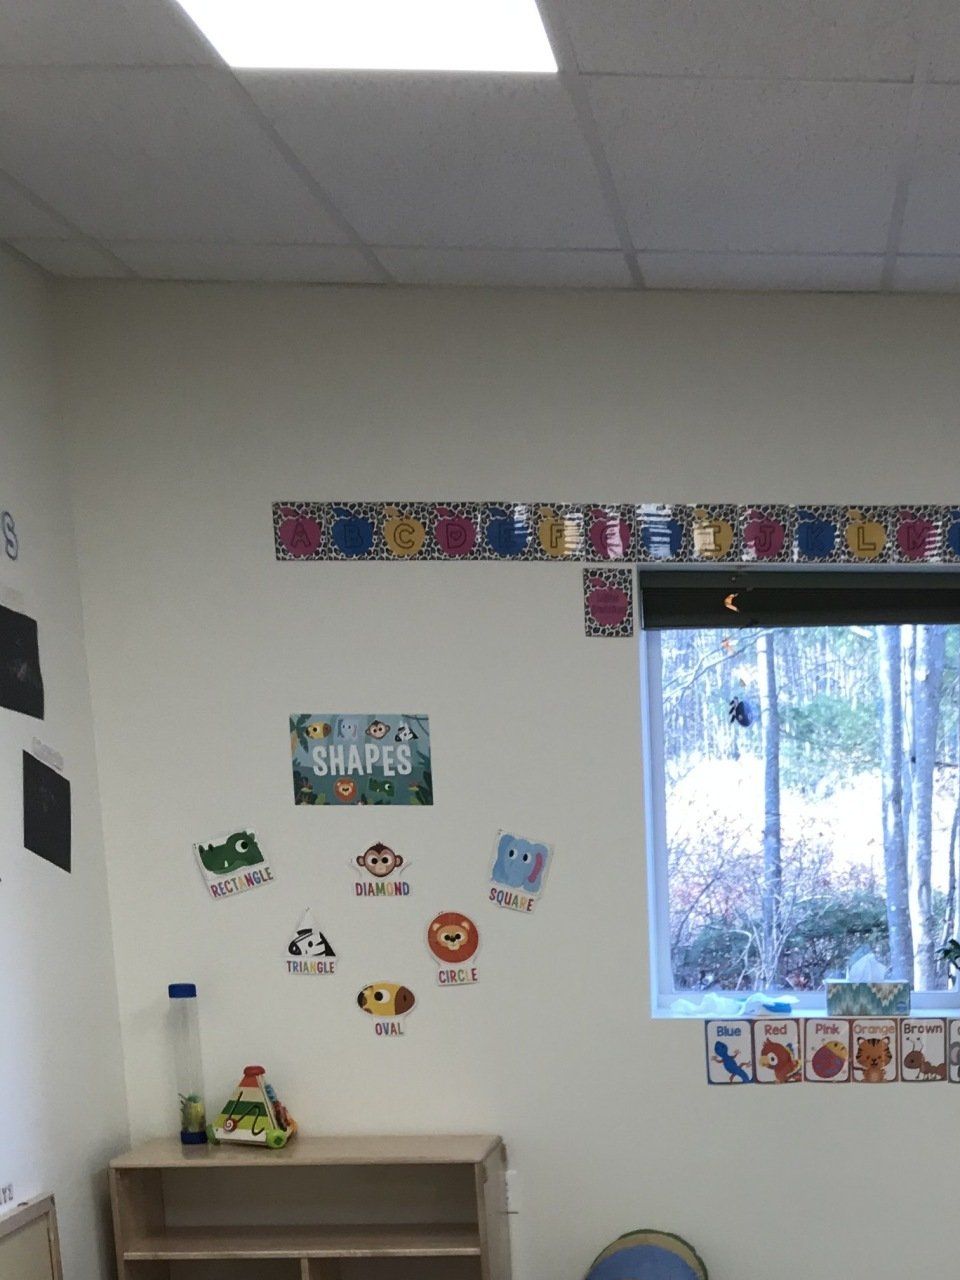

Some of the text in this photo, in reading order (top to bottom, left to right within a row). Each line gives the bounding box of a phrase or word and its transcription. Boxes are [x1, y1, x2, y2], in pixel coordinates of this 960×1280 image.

[290, 523, 312, 547] A
[344, 524, 364, 547] B
[394, 523, 415, 548] C
[446, 523, 467, 549] D
[550, 523, 565, 548] F
[755, 525, 775, 552] J
[857, 526, 876, 551] L
[312, 743, 412, 776] SHAPES
[210, 867, 274, 898] RECTANGLE
[355, 881, 410, 896] DIAMOND
[488, 887, 535, 912] SQUARE
[286, 960, 335, 974] TRIANGLE
[438, 968, 478, 984] CIRCLE
[375, 1022, 404, 1036] OVAL
[716, 1026, 741, 1037] Blue
[764, 1024, 787, 1036] Red
[815, 1023, 840, 1035] Pink
[853, 1024, 896, 1038] Orange
[904, 1023, 943, 1035] Brown
